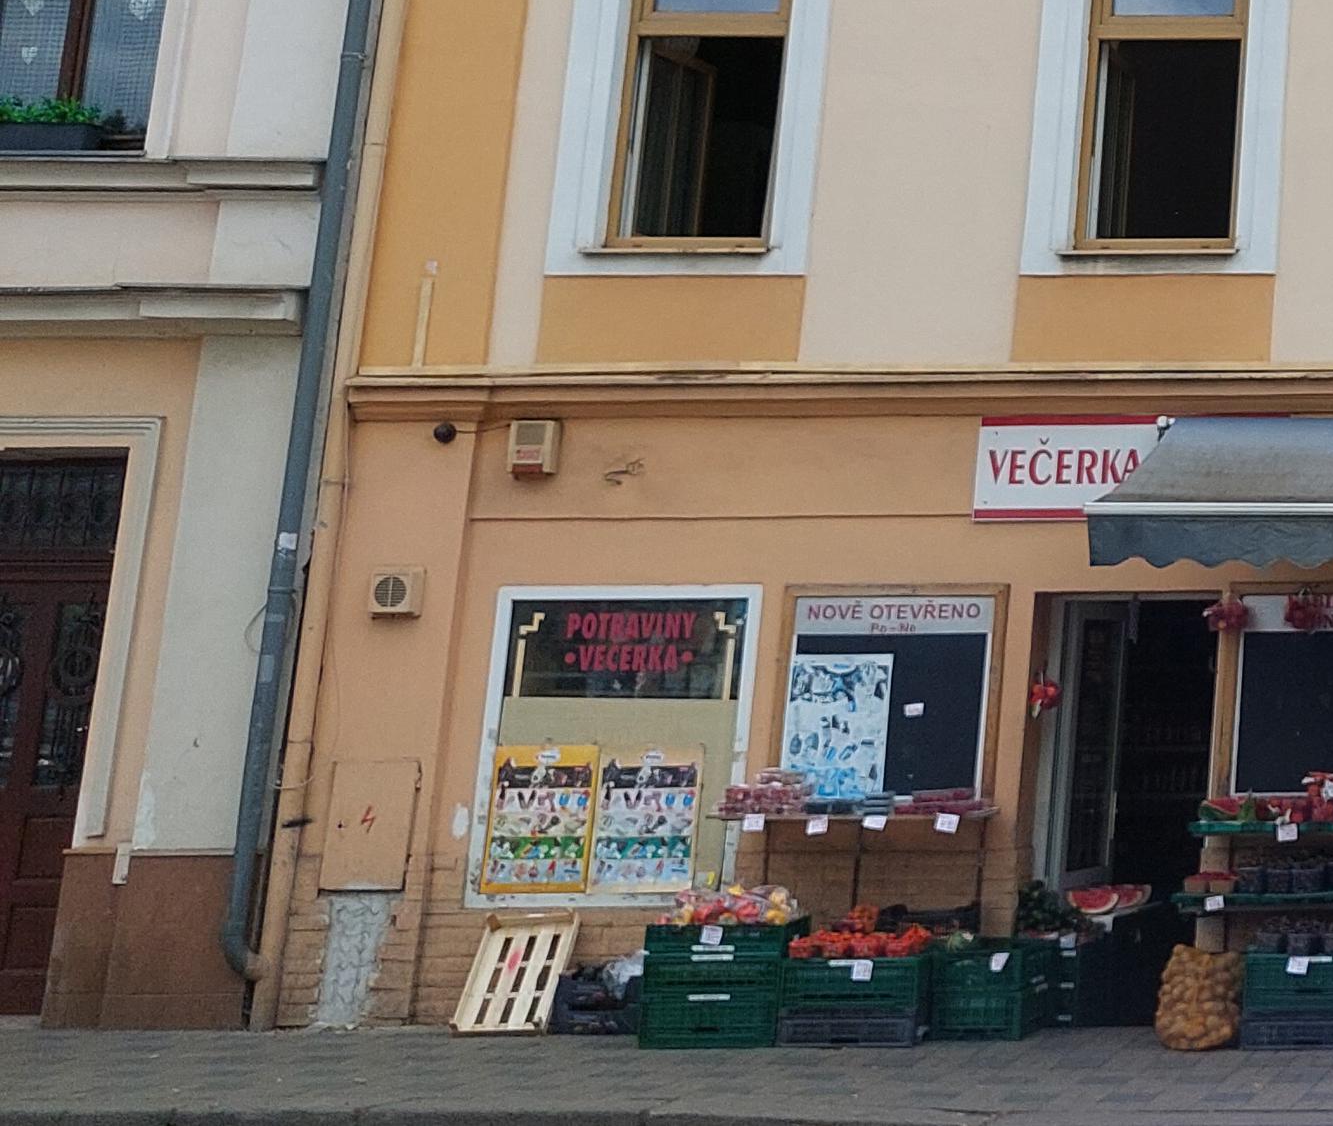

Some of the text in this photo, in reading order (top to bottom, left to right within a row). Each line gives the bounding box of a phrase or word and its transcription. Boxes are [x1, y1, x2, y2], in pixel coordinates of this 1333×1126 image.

[989, 437, 1142, 485] VEČERKA
[869, 599, 981, 620] OTEVŘENO
[565, 612, 698, 640] POTRAVINY
